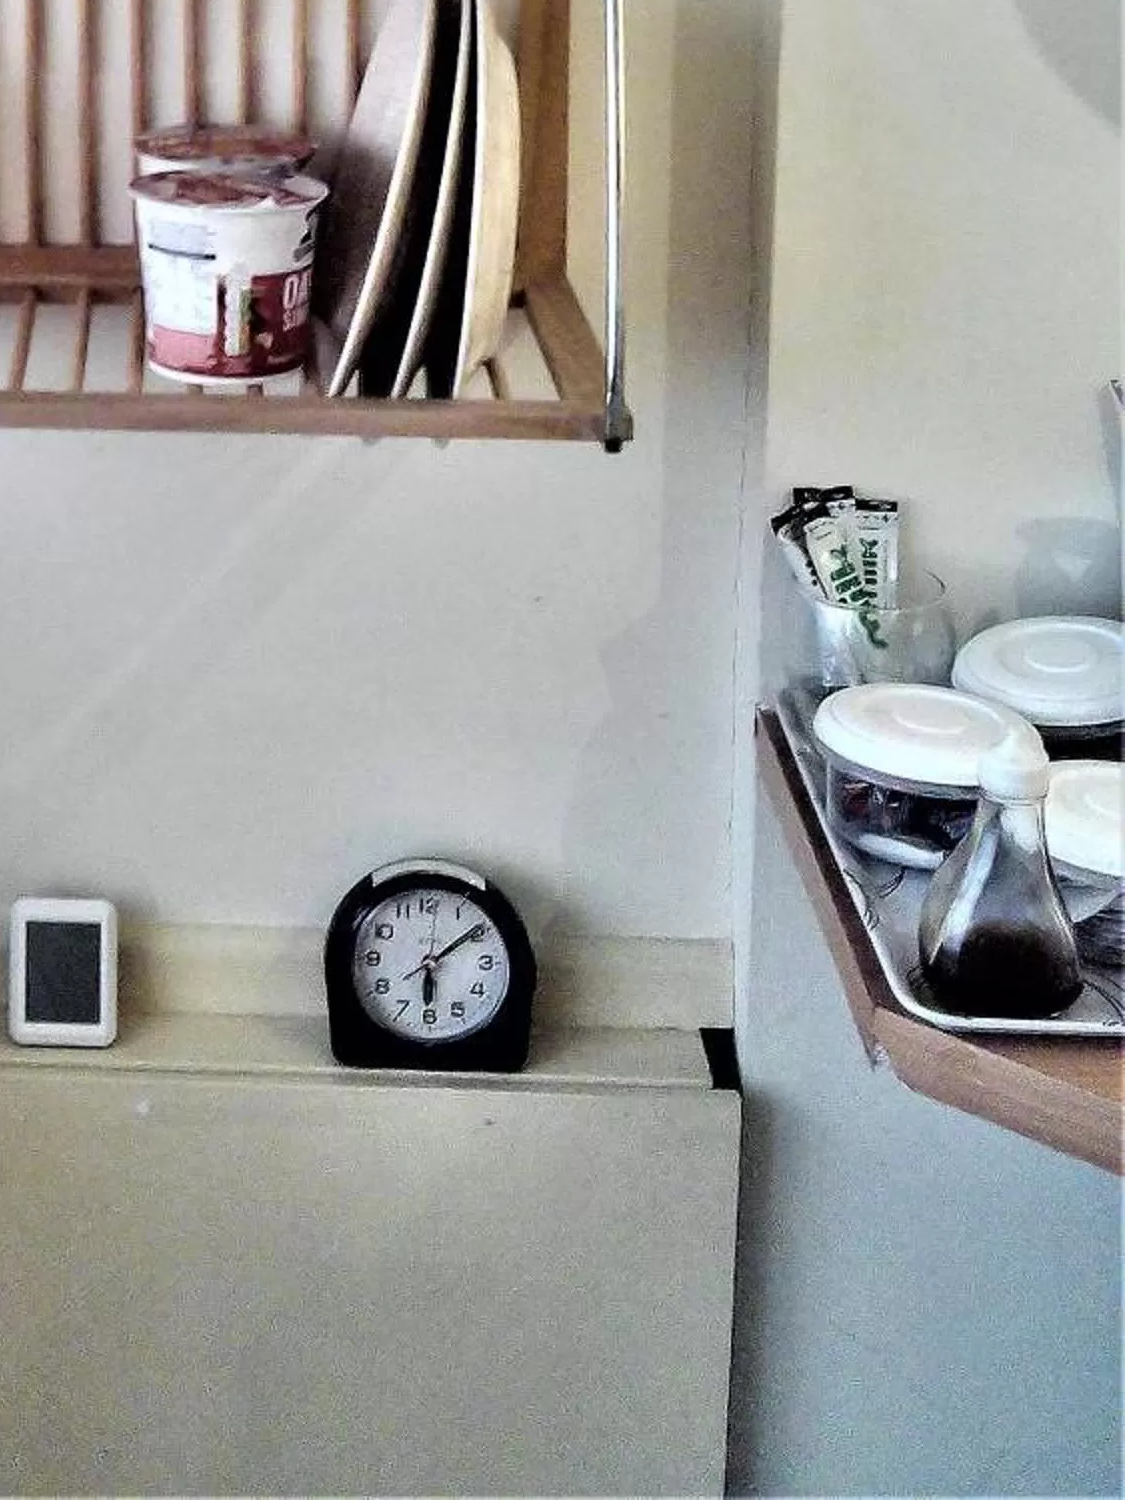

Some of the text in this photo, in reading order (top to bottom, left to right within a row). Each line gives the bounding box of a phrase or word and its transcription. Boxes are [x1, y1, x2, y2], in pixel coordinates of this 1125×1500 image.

[477, 954, 494, 971] 3
[374, 977, 486, 998] 8 4
[422, 1008, 438, 1025] 6
[450, 1001, 466, 1018] 5
